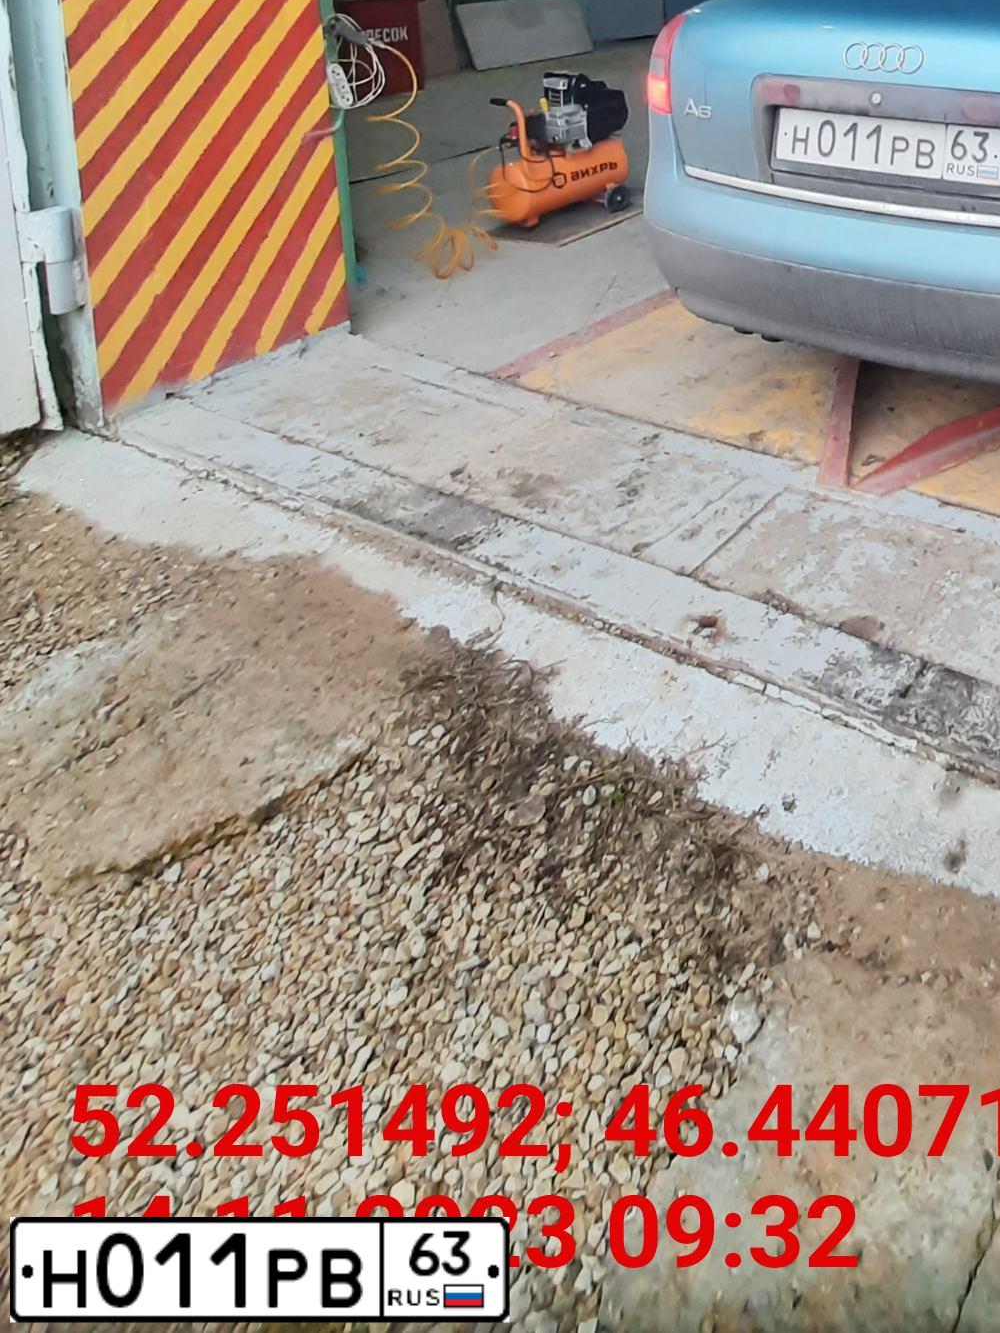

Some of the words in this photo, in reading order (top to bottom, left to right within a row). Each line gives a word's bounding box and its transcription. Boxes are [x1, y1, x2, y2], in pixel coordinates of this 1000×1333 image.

[683, 97, 712, 119] A6
[791, 119, 936, 169] Н011РВ
[950, 129, 990, 164] 63
[946, 162, 976, 177] RUS
